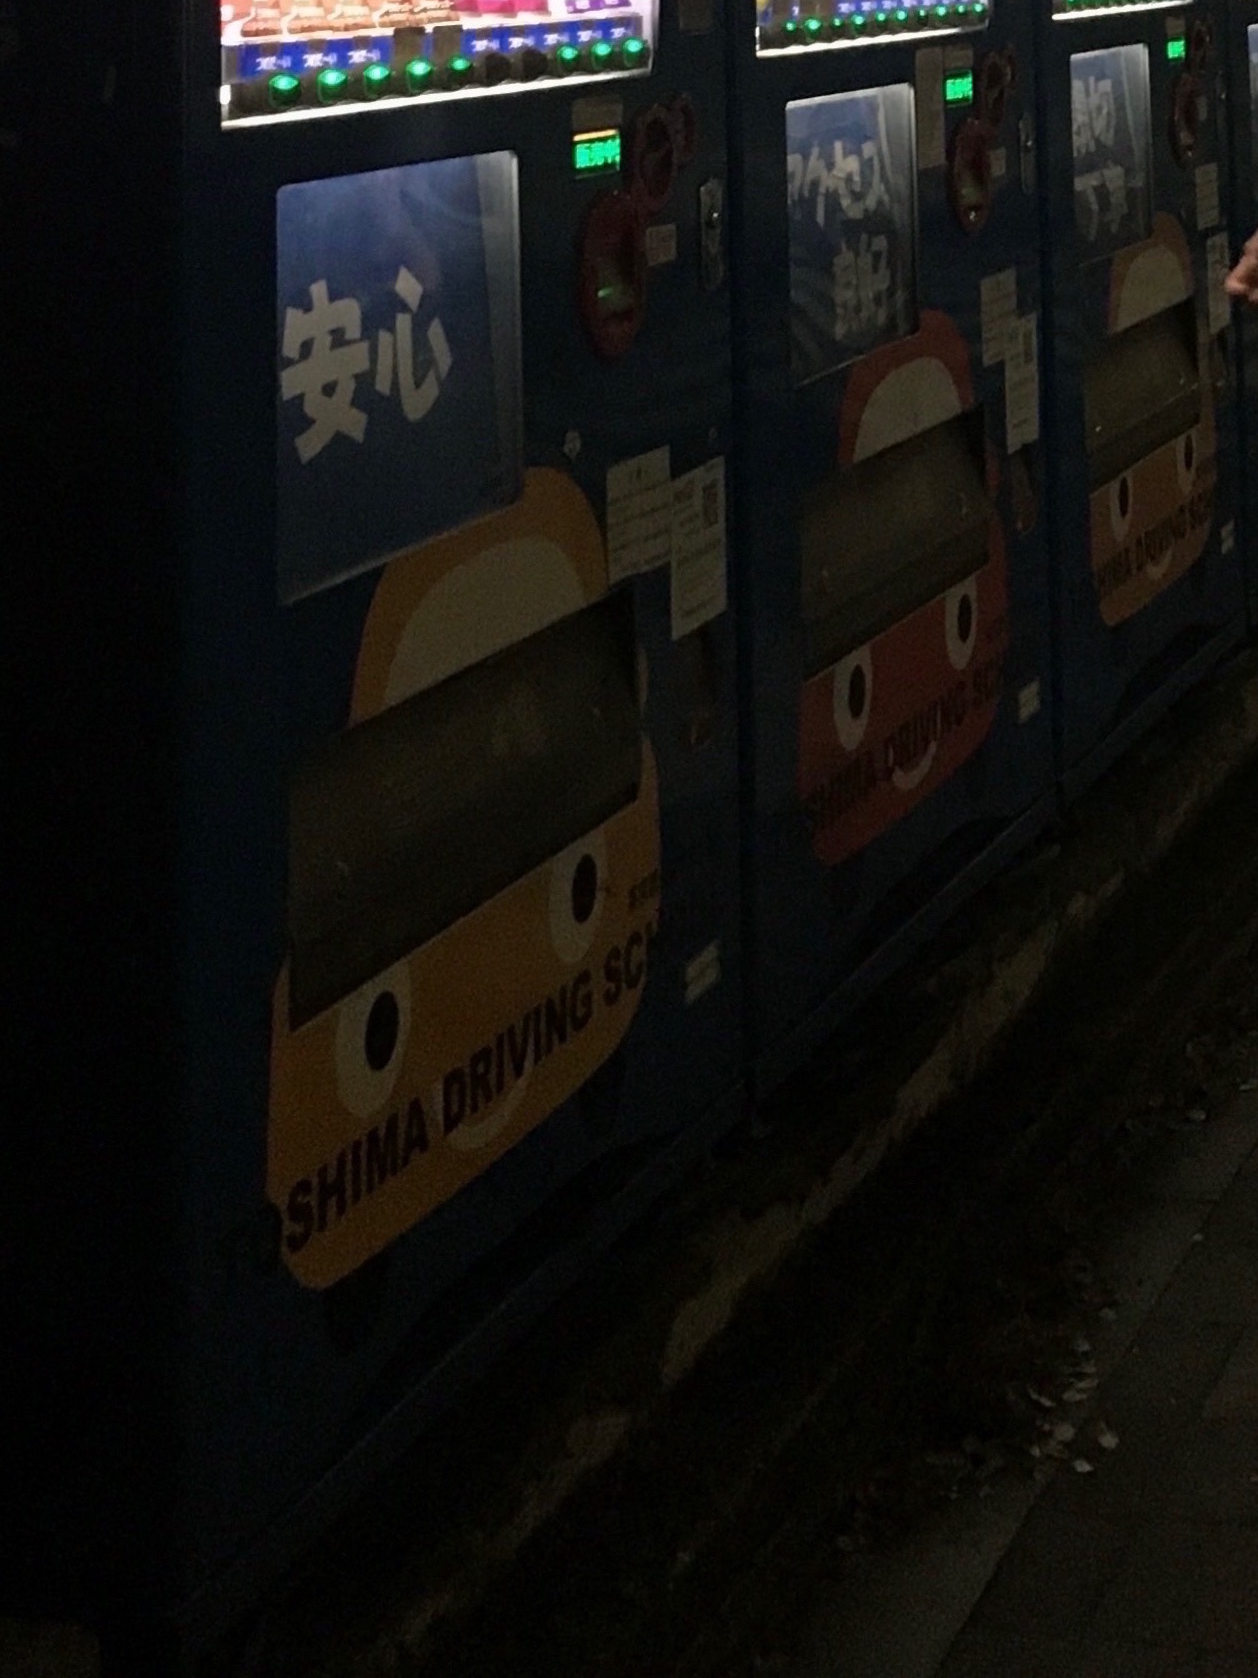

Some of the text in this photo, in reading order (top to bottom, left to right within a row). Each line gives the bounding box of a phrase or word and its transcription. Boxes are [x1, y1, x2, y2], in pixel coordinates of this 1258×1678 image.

[280, 264, 453, 464] 安心
[280, 1095, 429, 1254] SHIMA
[442, 968, 593, 1136] DRIVING
